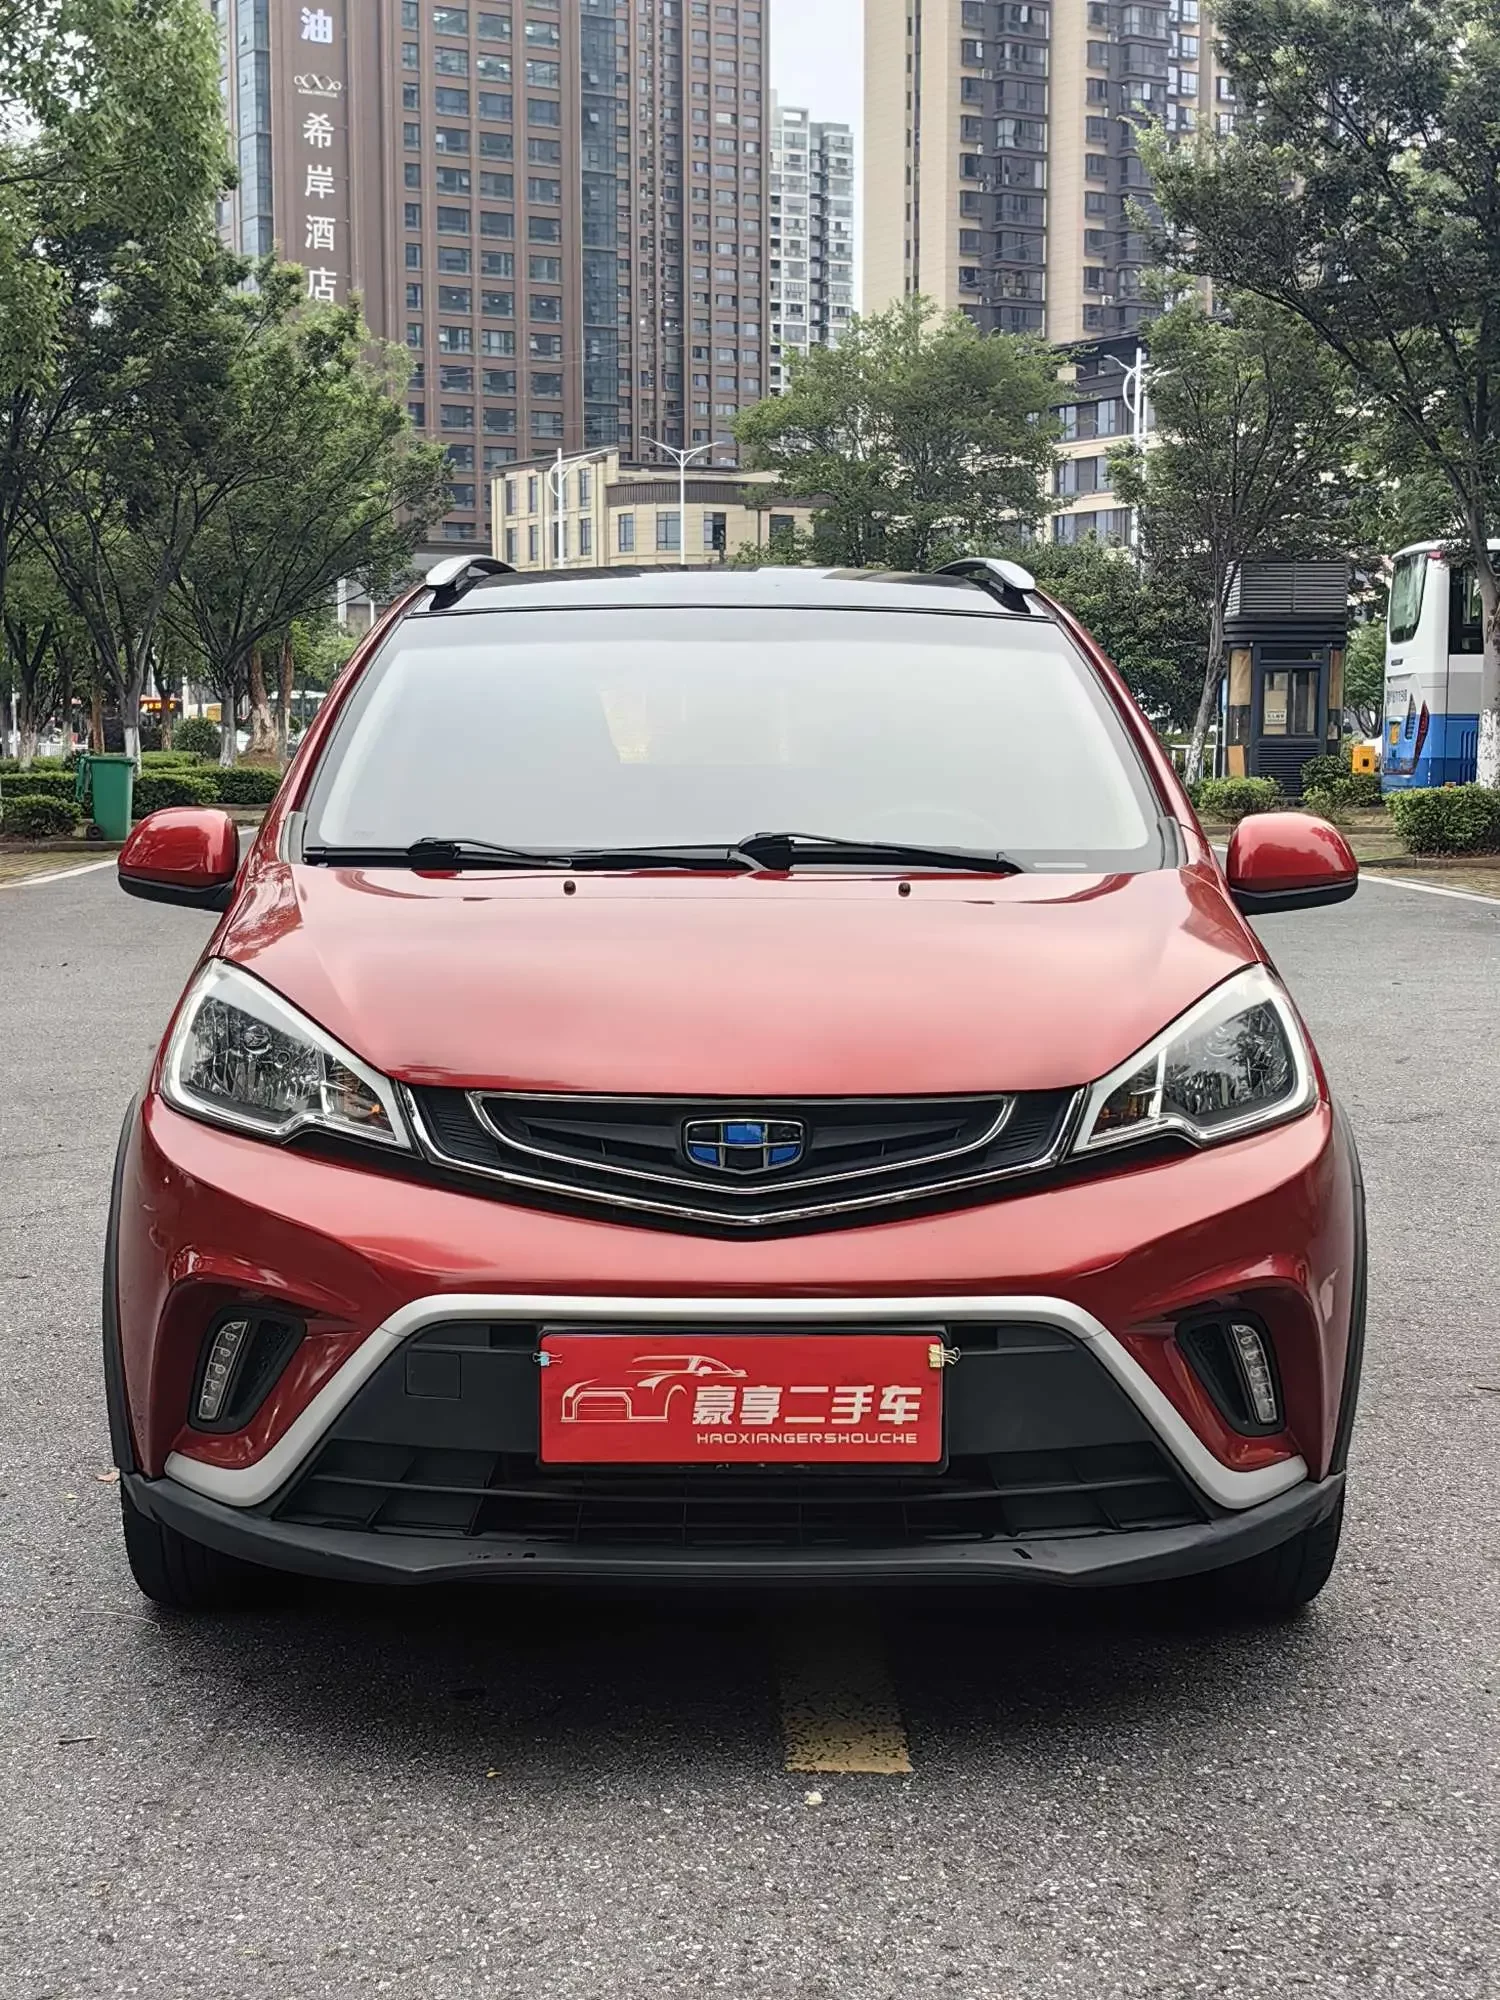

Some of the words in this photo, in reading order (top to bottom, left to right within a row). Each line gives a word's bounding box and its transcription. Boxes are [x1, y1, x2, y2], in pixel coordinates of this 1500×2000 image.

[301, 7, 333, 44] 油
[303, 112, 337, 302] 希岸酒店
[692, 1385, 922, 1425] 豪享二手车
[696, 1432, 918, 1444] HAOXIANGERSHOUCHE
